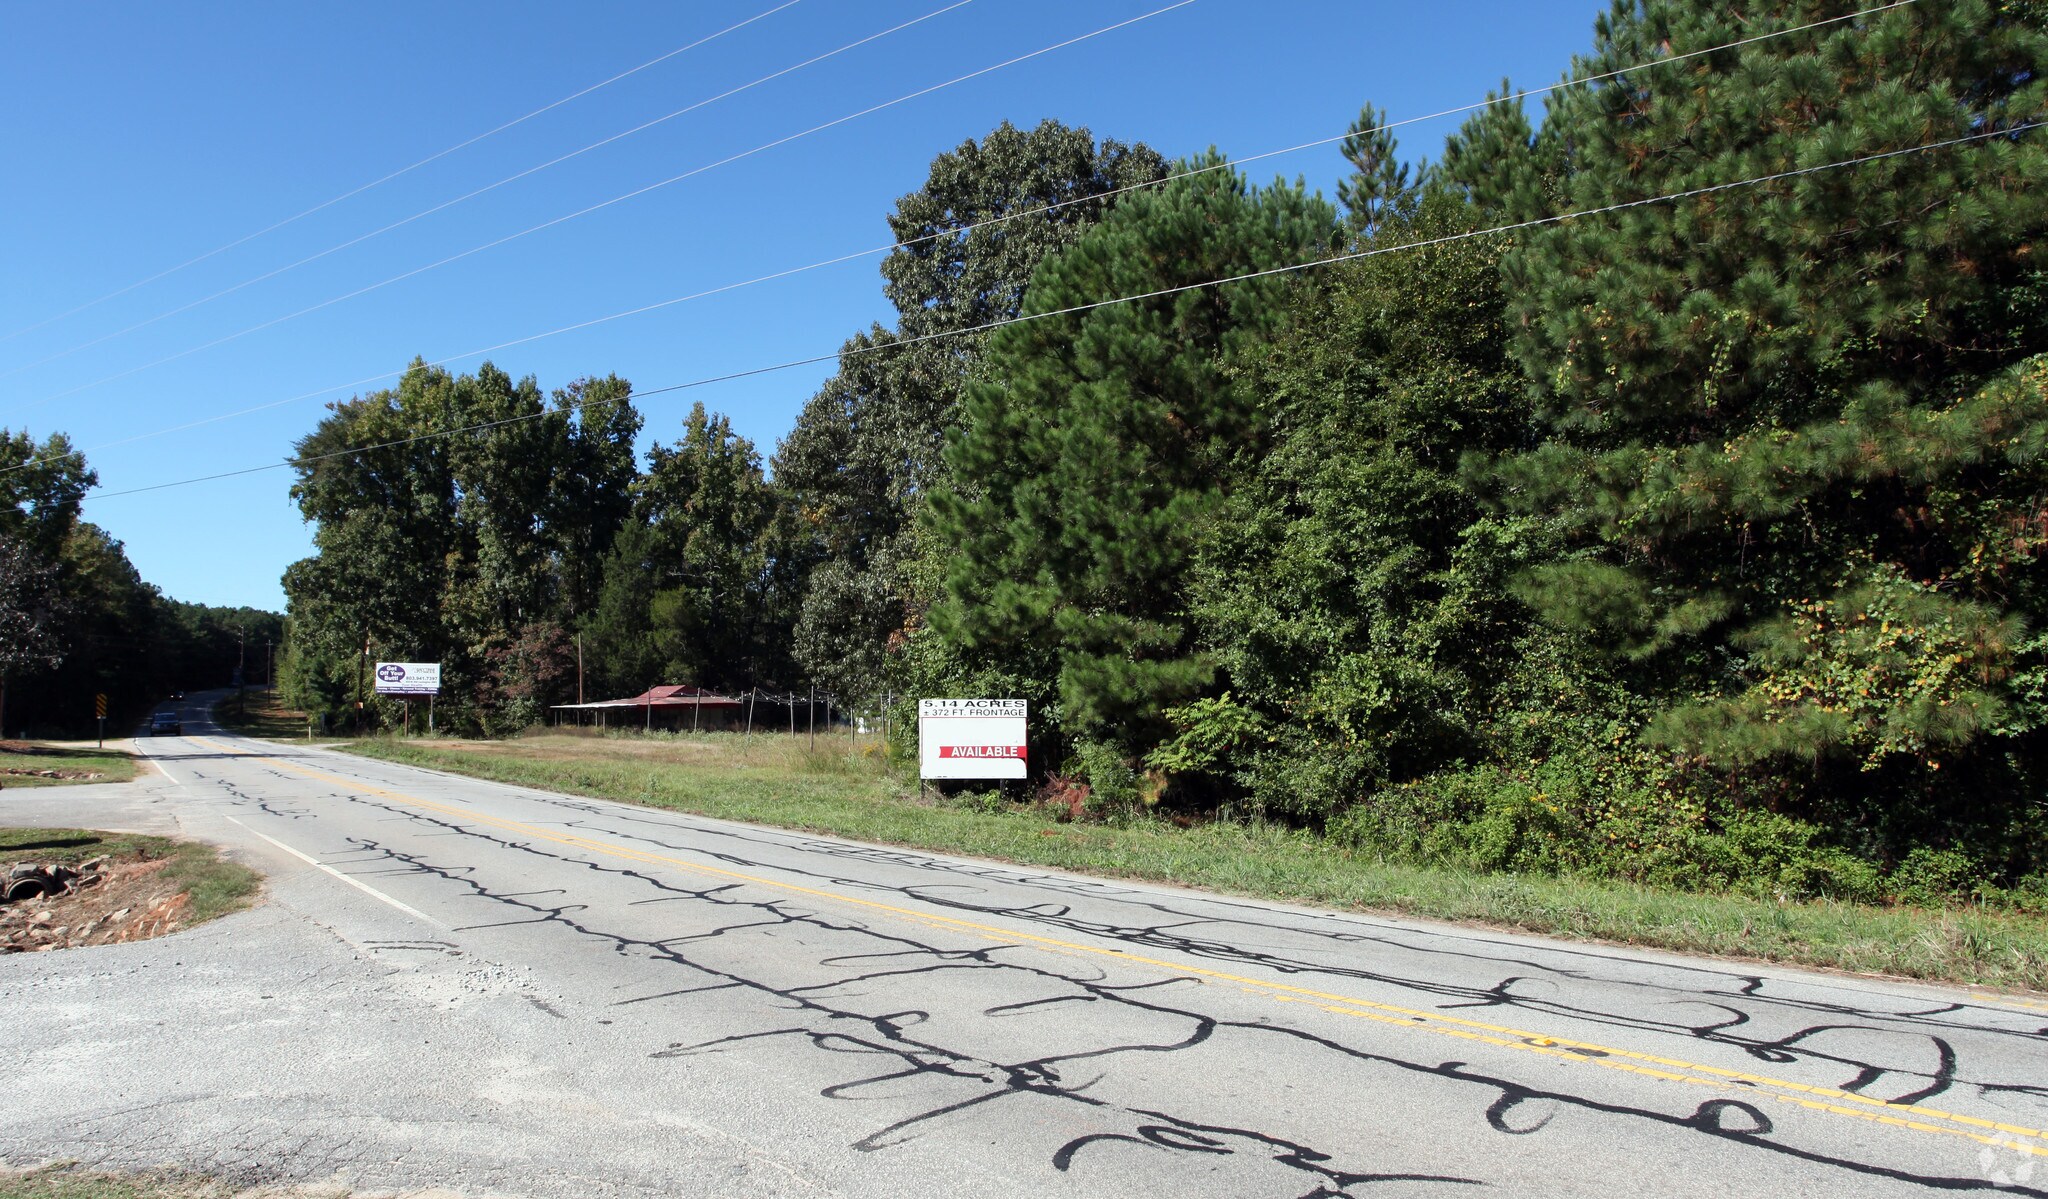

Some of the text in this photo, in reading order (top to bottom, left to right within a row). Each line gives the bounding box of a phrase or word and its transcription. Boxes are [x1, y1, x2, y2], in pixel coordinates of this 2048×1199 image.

[924, 700, 1025, 708] 5.14 ACRES
[951, 746, 1018, 757] AVAILABLE
